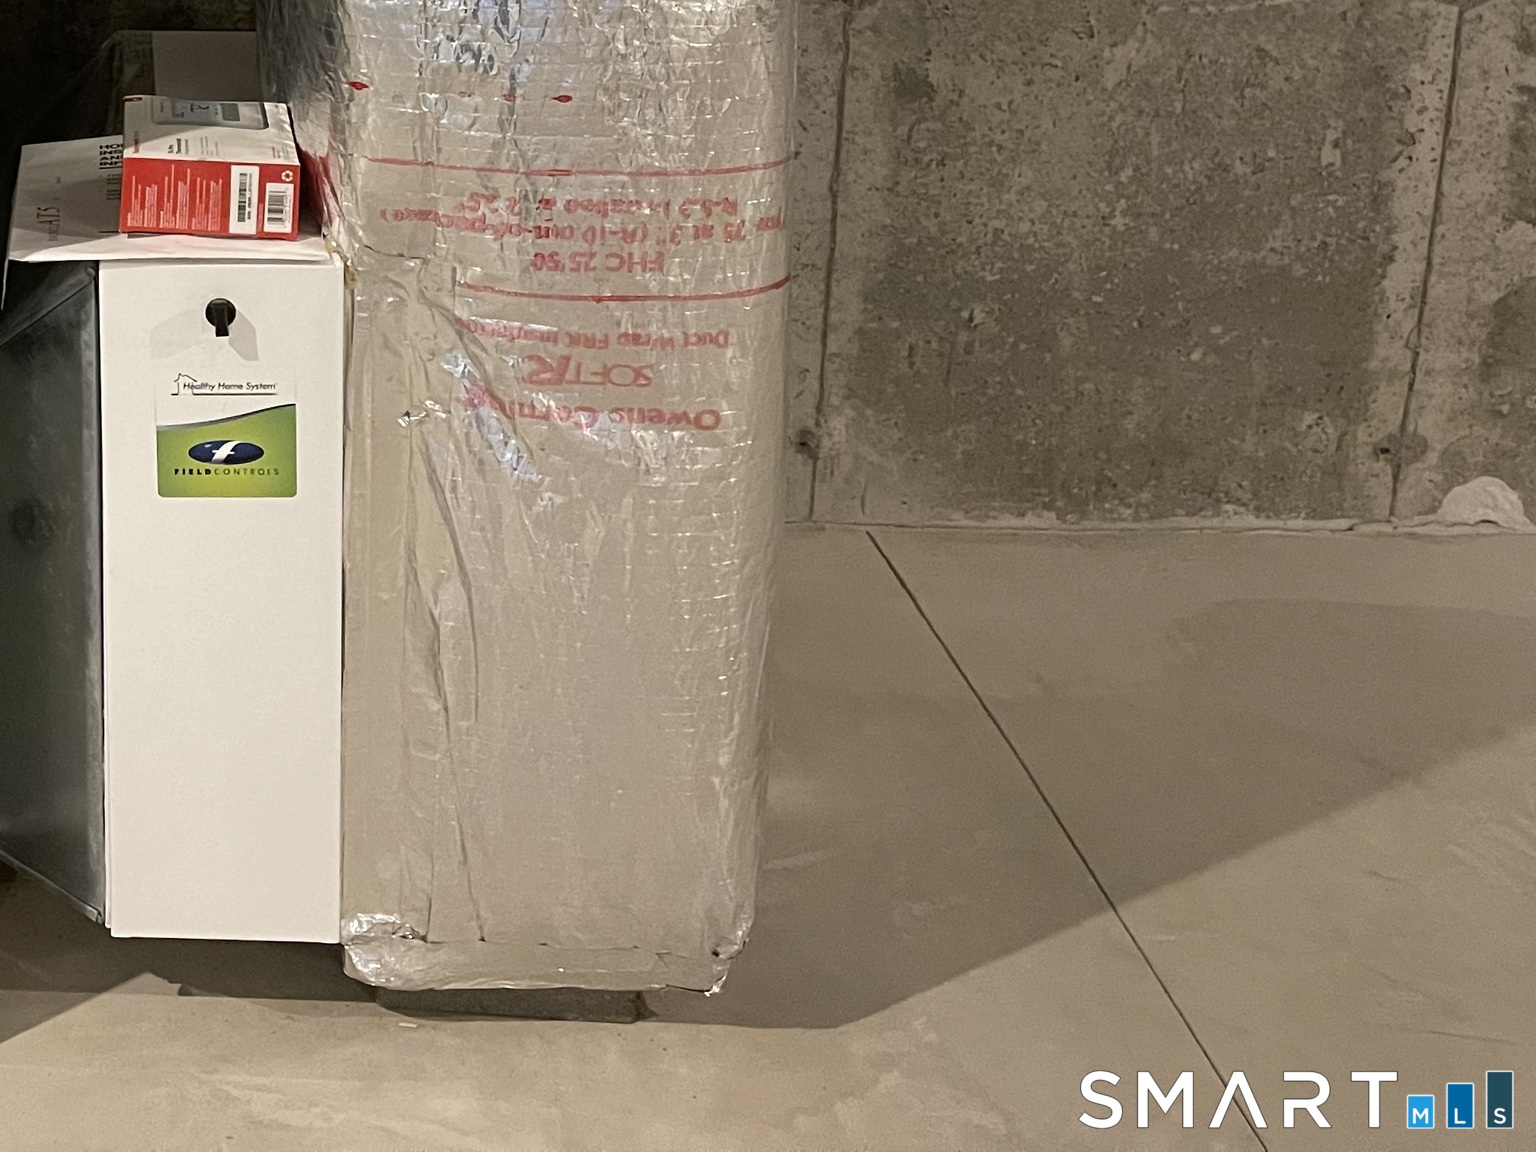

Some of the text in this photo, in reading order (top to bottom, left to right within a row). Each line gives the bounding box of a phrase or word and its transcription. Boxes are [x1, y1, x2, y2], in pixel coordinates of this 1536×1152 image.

[604, 252, 664, 272] FHC
[682, 328, 730, 348] Duct
[183, 382, 215, 391] Healthy
[218, 382, 244, 390] Home
[610, 406, 723, 431] Owens
